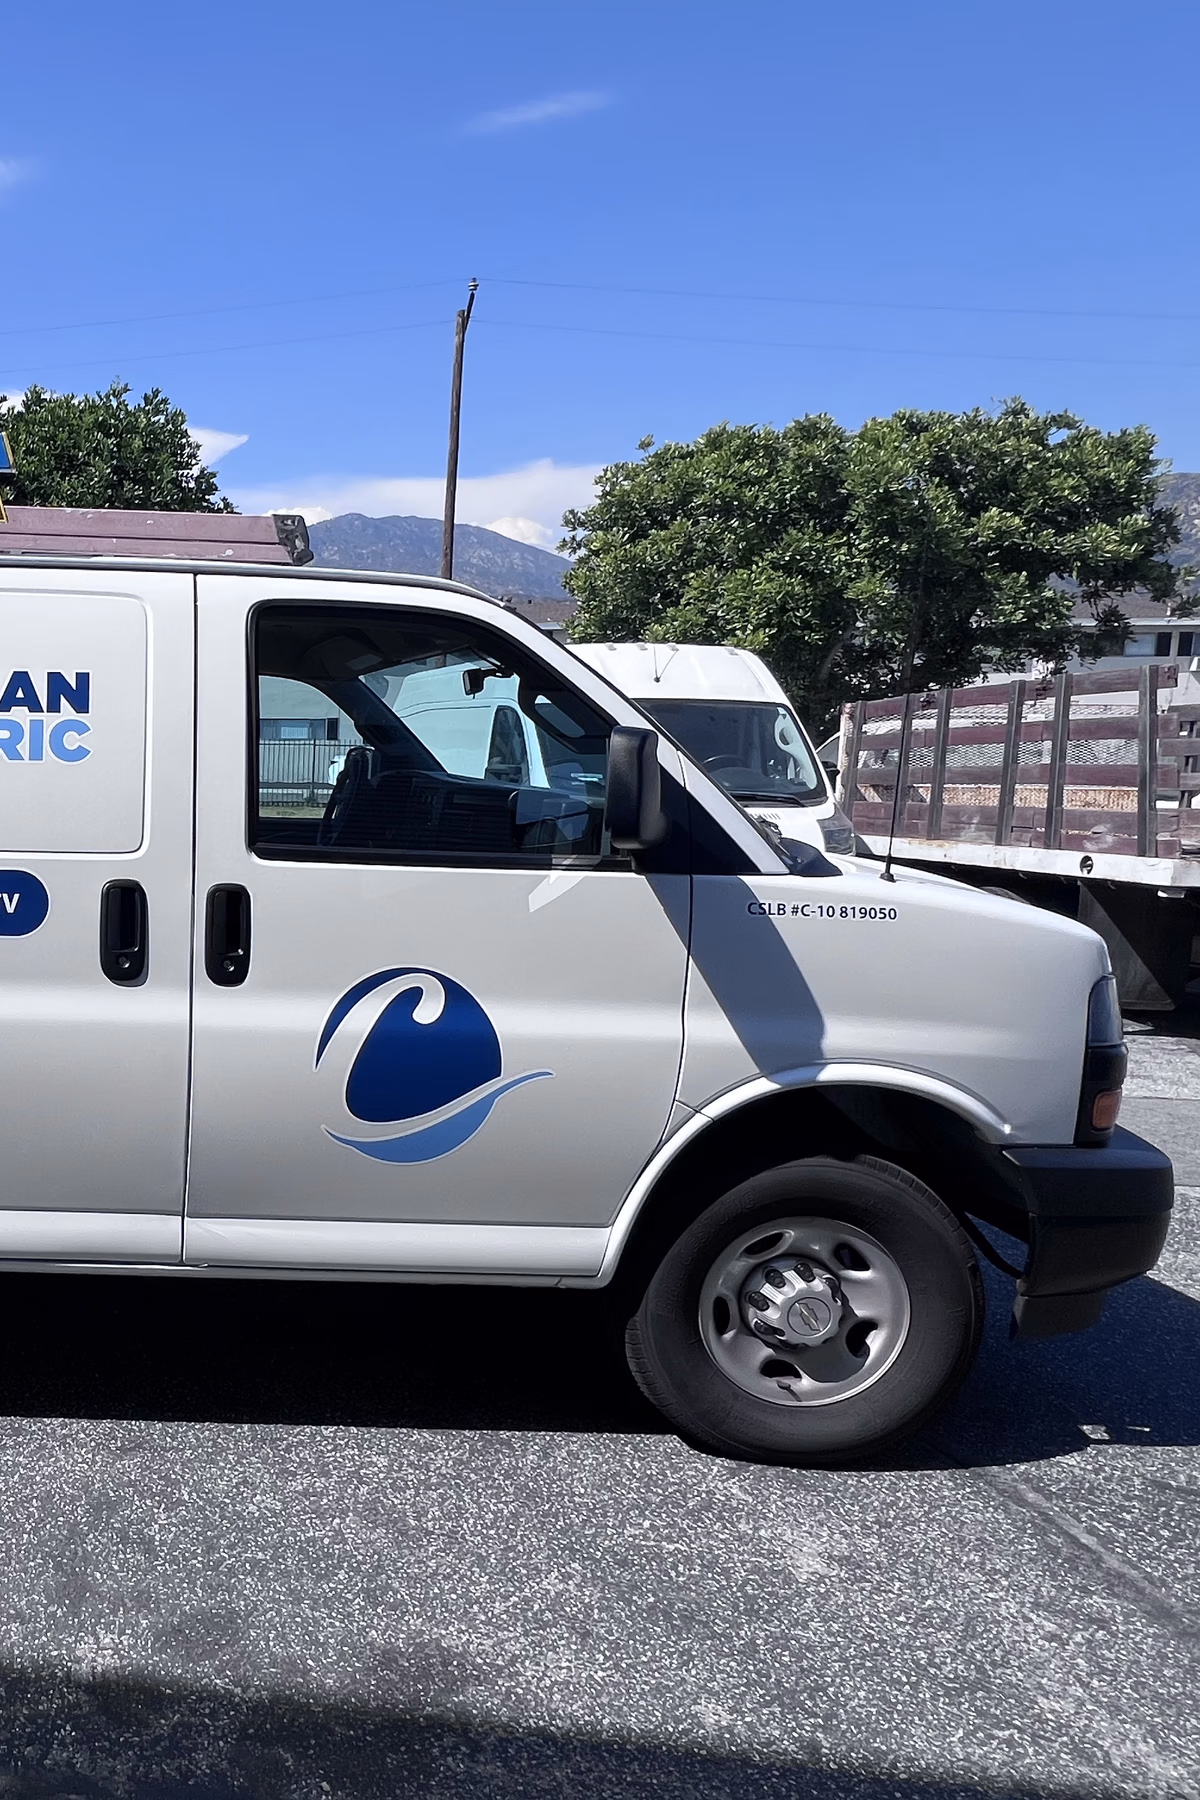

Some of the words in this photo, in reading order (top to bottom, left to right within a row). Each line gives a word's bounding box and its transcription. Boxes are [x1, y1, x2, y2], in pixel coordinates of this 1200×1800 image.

[747, 902, 786, 915] CSLB
[791, 904, 835, 917] #C-10
[840, 906, 897, 919] 819050
